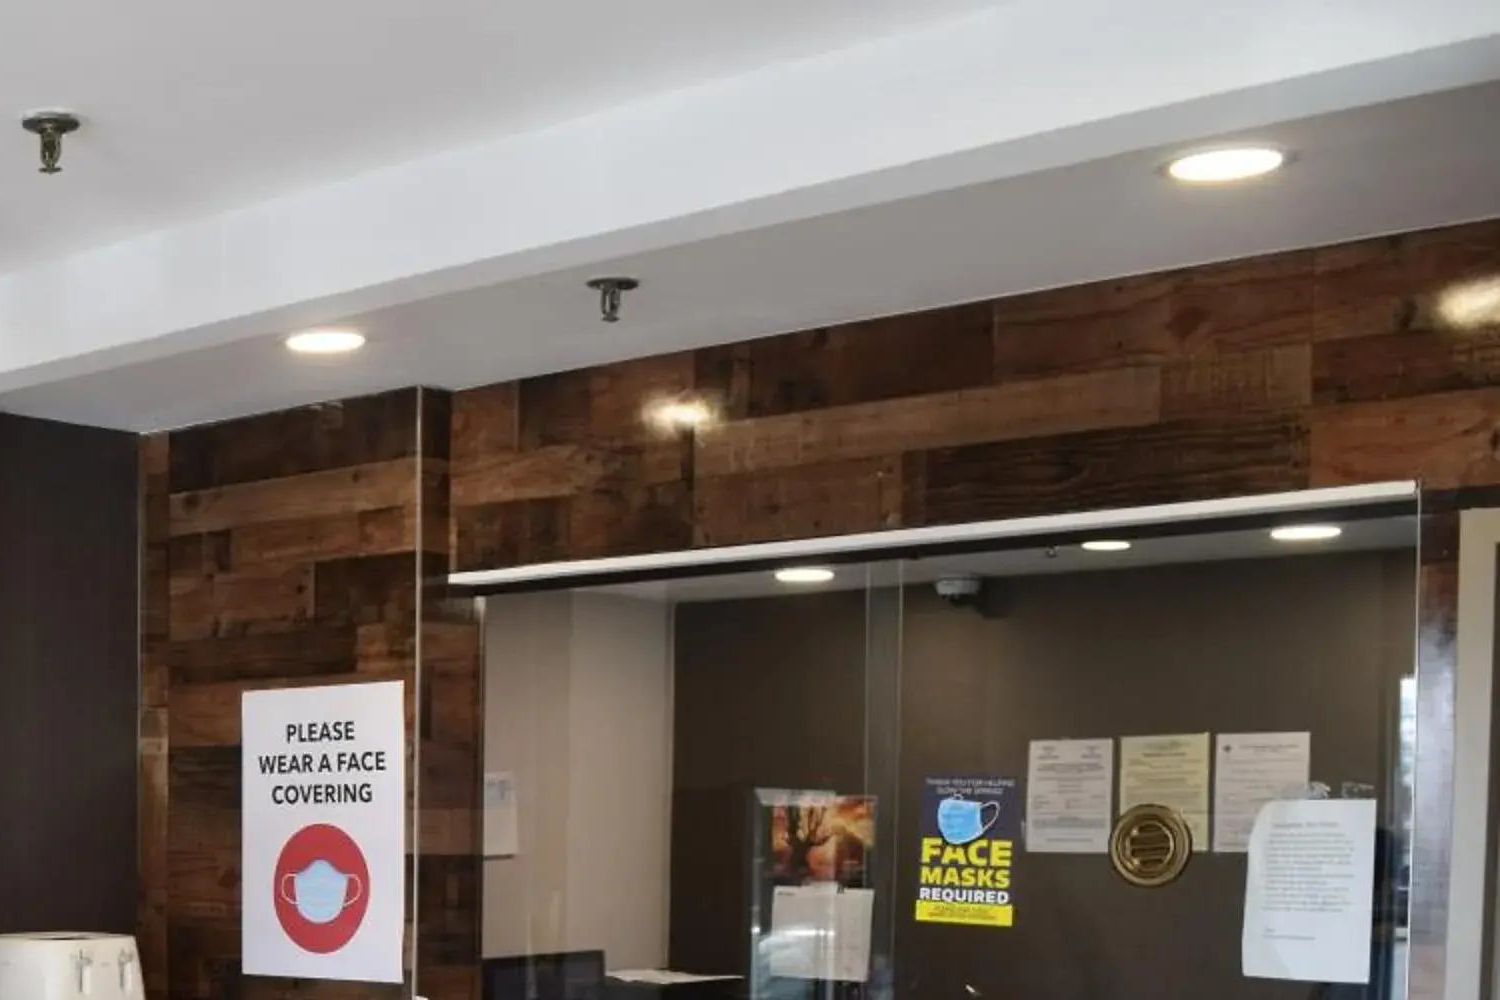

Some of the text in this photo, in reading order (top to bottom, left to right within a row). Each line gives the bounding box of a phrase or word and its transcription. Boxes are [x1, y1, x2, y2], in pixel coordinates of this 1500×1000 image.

[286, 721, 355, 743] PLEASE
[259, 751, 387, 775] WEAR A FACE
[271, 783, 373, 805] COVERING
[921, 837, 1013, 867] FACE
[920, 866, 1011, 889] MASKS
[919, 887, 1009, 905] REQUIRED
